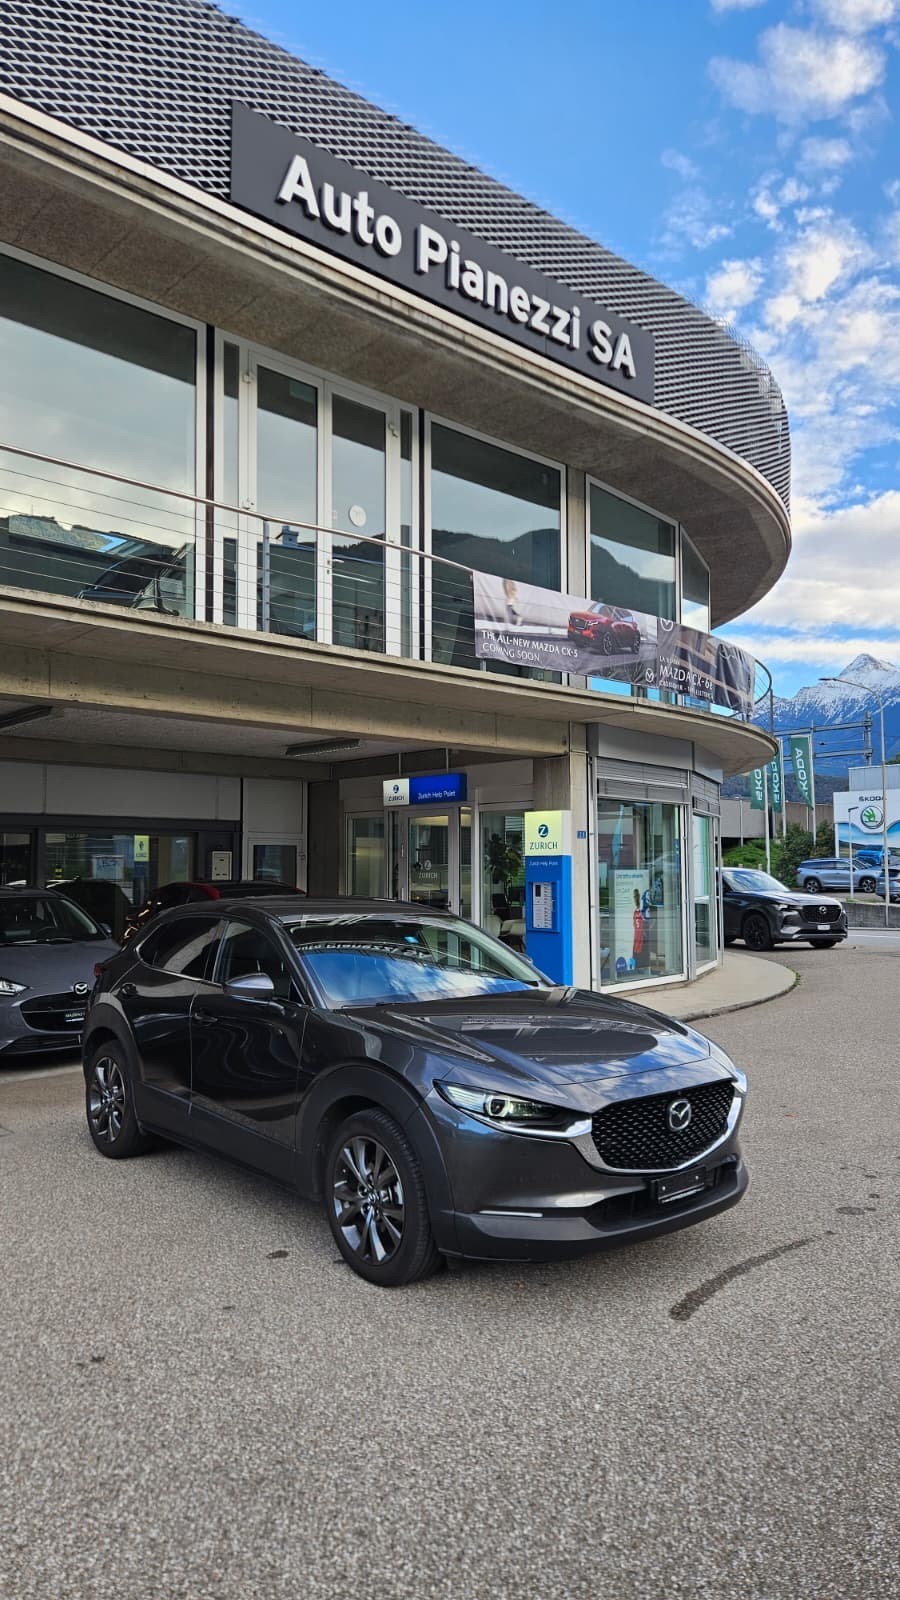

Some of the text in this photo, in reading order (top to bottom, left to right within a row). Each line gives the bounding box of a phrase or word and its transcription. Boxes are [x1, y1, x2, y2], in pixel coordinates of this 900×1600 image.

[276, 154, 637, 379] Auto Pianezzi SA
[481, 630, 578, 658] THE ALL-NEW MAZDA CX-5
[482, 642, 540, 662] COMING SOON
[660, 664, 691, 682] MAZDA
[443, 789, 456, 798] Point
[529, 841, 558, 850] ZURICH
